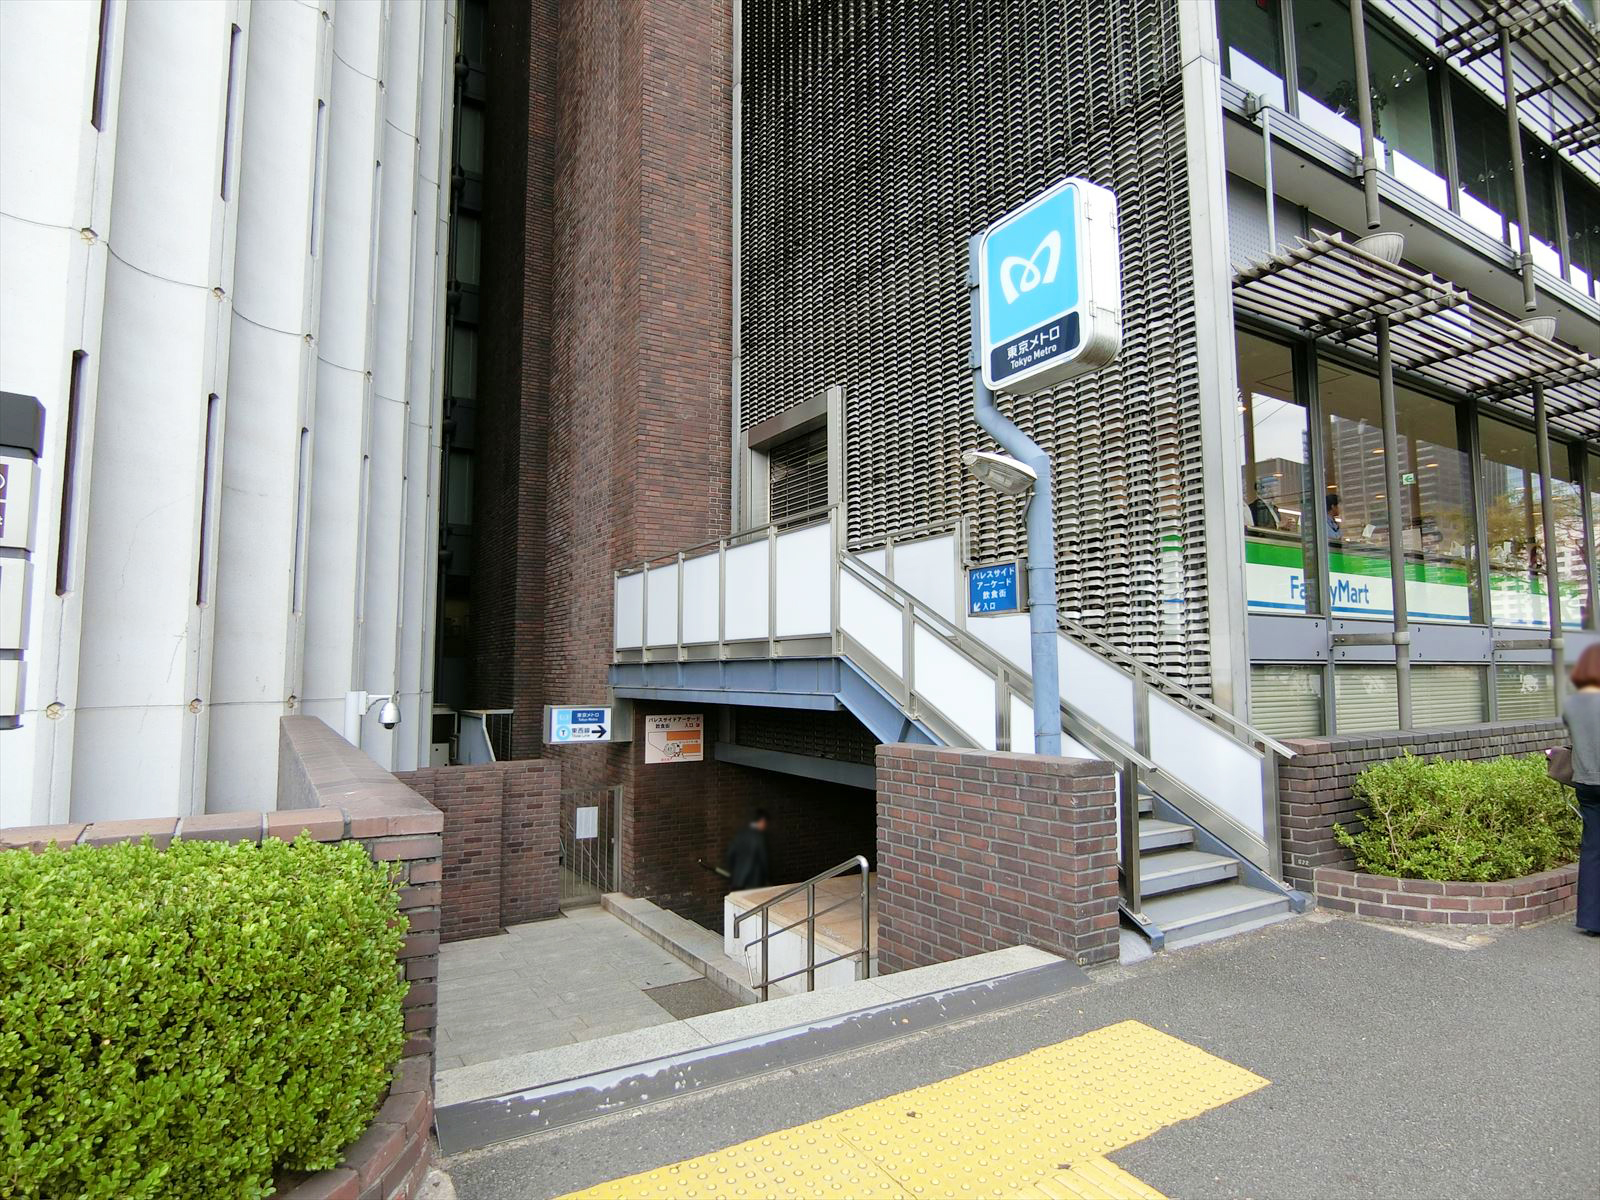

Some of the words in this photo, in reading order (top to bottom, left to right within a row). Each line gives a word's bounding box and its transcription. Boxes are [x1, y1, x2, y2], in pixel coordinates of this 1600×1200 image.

[1007, 325, 1060, 360] 東京メトロ
[1010, 355, 1032, 369] Tokyo
[1033, 344, 1057, 360] Metro
[972, 567, 1014, 580] パレスサイド
[976, 577, 1012, 590] アーケード
[982, 588, 1007, 600] 飲食街
[1290, 575, 1370, 606] FayMart
[982, 602, 996, 611] 入口
